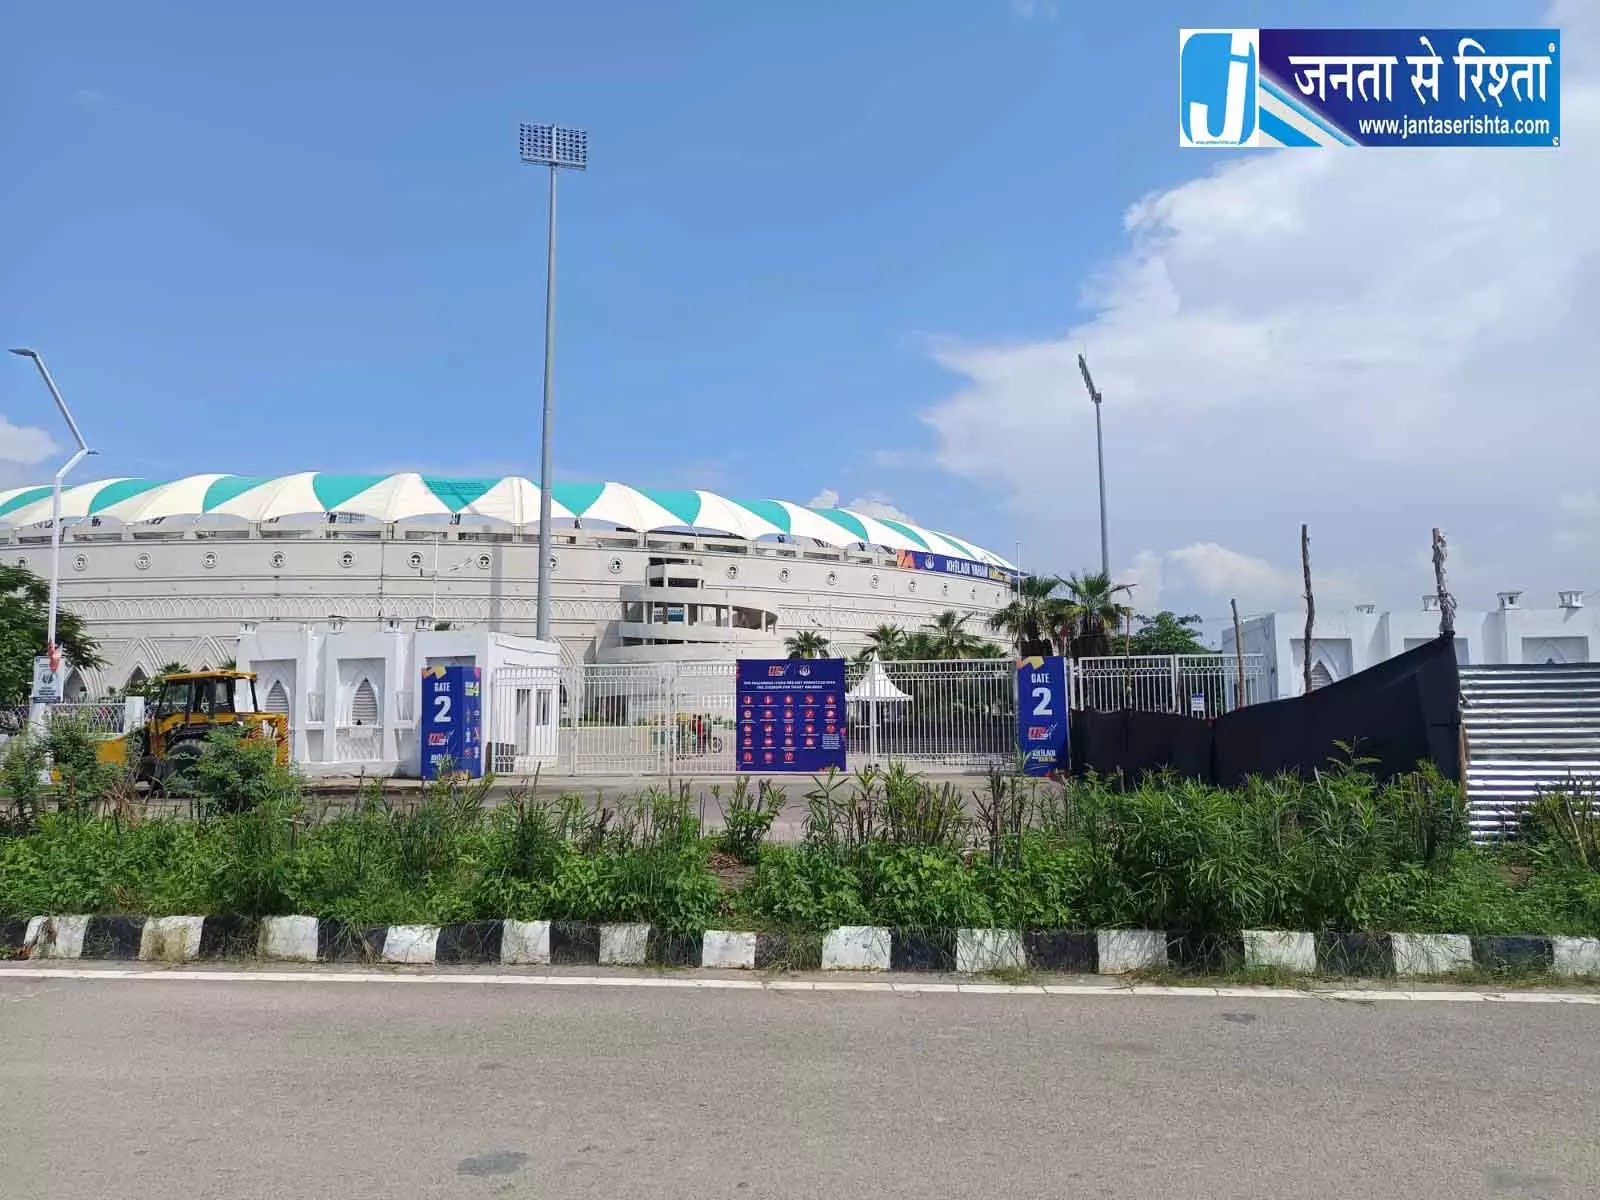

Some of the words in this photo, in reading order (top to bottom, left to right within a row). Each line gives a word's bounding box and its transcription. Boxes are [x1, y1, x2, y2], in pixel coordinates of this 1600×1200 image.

[434, 682, 450, 692] GATE
[1031, 673, 1049, 683] GATE
[434, 695, 451, 723] 2
[1032, 687, 1053, 716] 2
